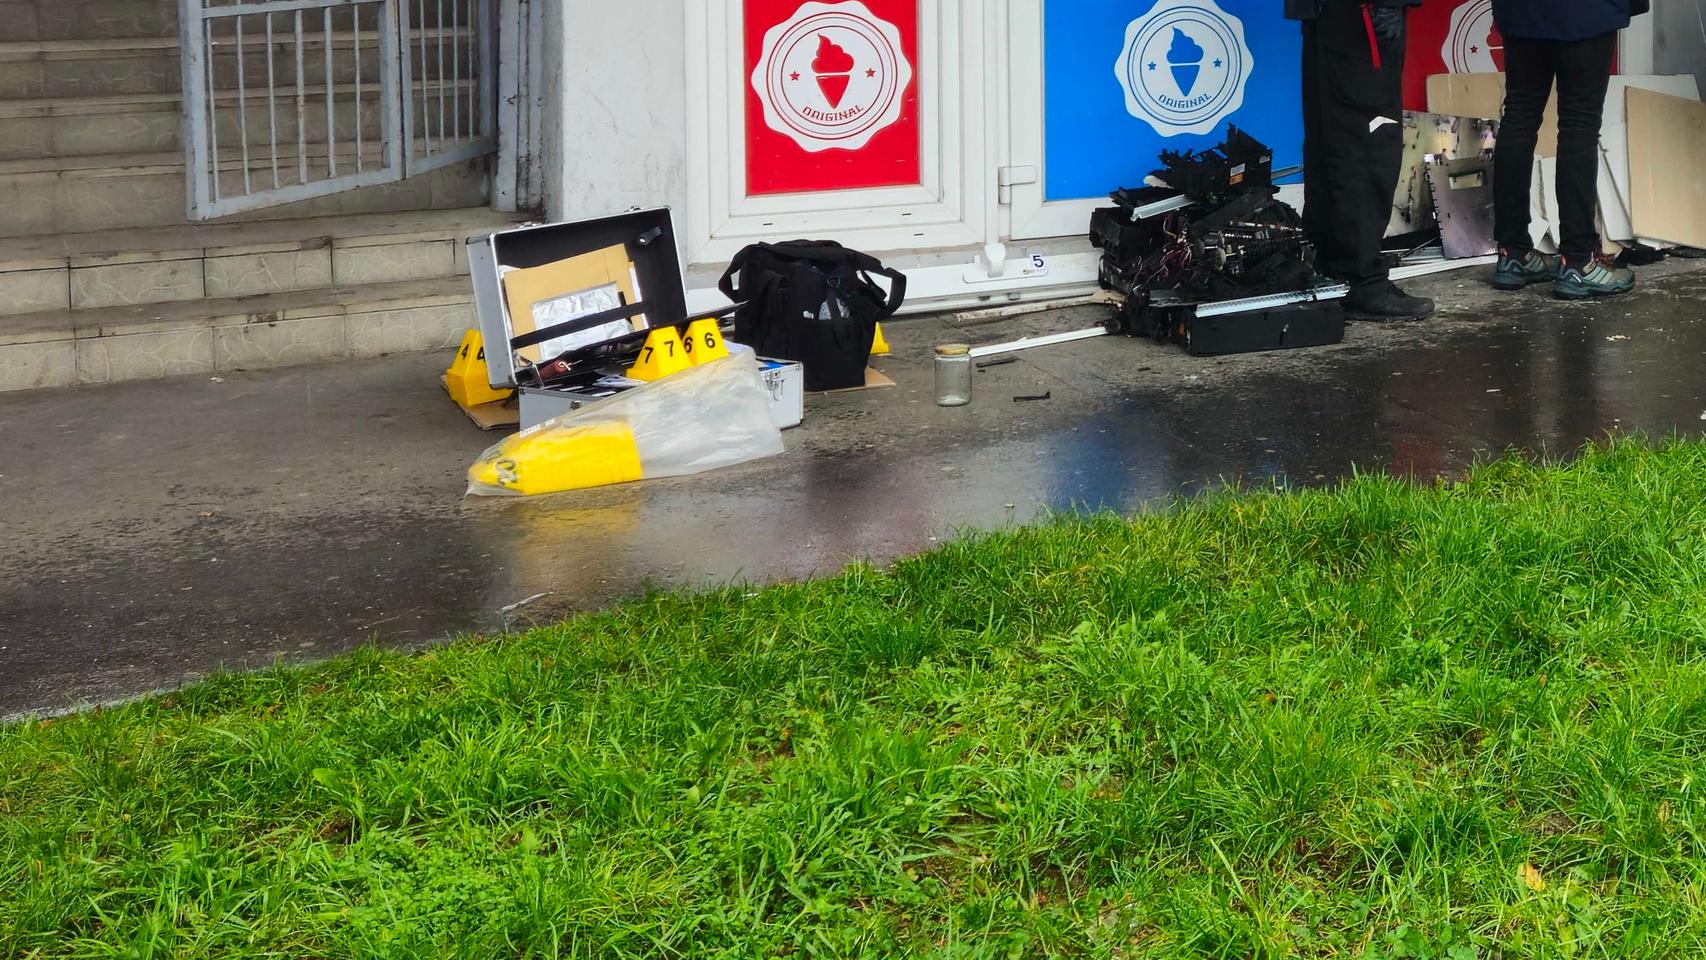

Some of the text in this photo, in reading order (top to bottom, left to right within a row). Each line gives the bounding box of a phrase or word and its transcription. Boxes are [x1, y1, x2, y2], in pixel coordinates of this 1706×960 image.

[1158, 93, 1212, 109] ORIGINAL
[802, 104, 864, 122] ORIGINAL
[1032, 254, 1045, 268] 5
[664, 340, 674, 357] 7
[683, 336, 693, 354] 6
[704, 332, 716, 349] 6
[461, 344, 470, 360] 4
[644, 346, 654, 364] 7
